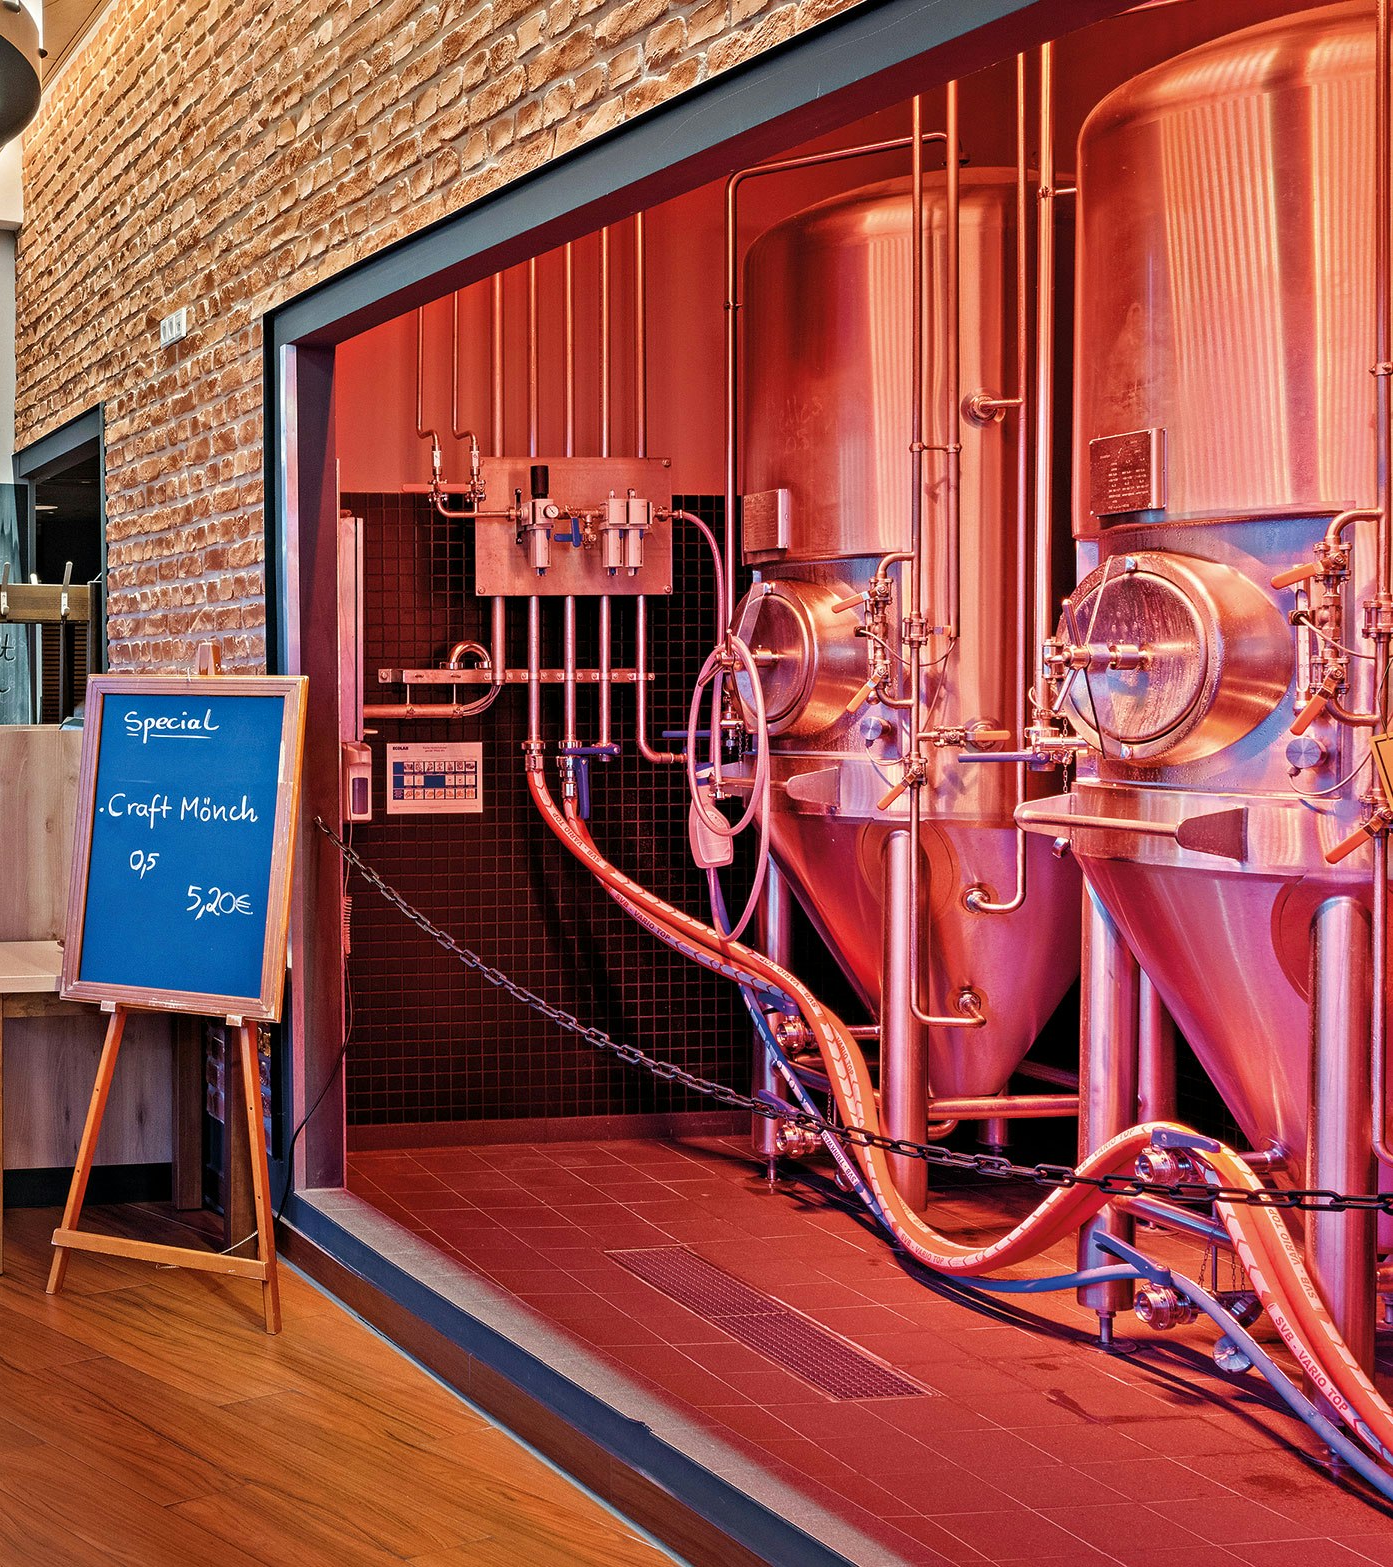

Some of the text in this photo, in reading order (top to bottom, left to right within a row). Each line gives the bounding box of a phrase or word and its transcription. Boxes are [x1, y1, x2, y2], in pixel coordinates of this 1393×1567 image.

[124, 709, 220, 744] Special
[180, 794, 259, 823] Mönch
[130, 850, 160, 880] 0,5
[186, 885, 254, 920] 5,20€
[615, 894, 630, 908] SVB
[634, 910, 655, 930] VARIO
[656, 927, 671, 940] TOP
[822, 1132, 845, 1166] TRINKWAS
[1268, 1208, 1284, 1229] TOP
[1280, 1233, 1301, 1266] VARIO
[1300, 1276, 1318, 1300] SVB
[1275, 1316, 1295, 1342] SVB
[1298, 1350, 1327, 1388] VARIO
[1327, 1387, 1349, 1411] TOP
